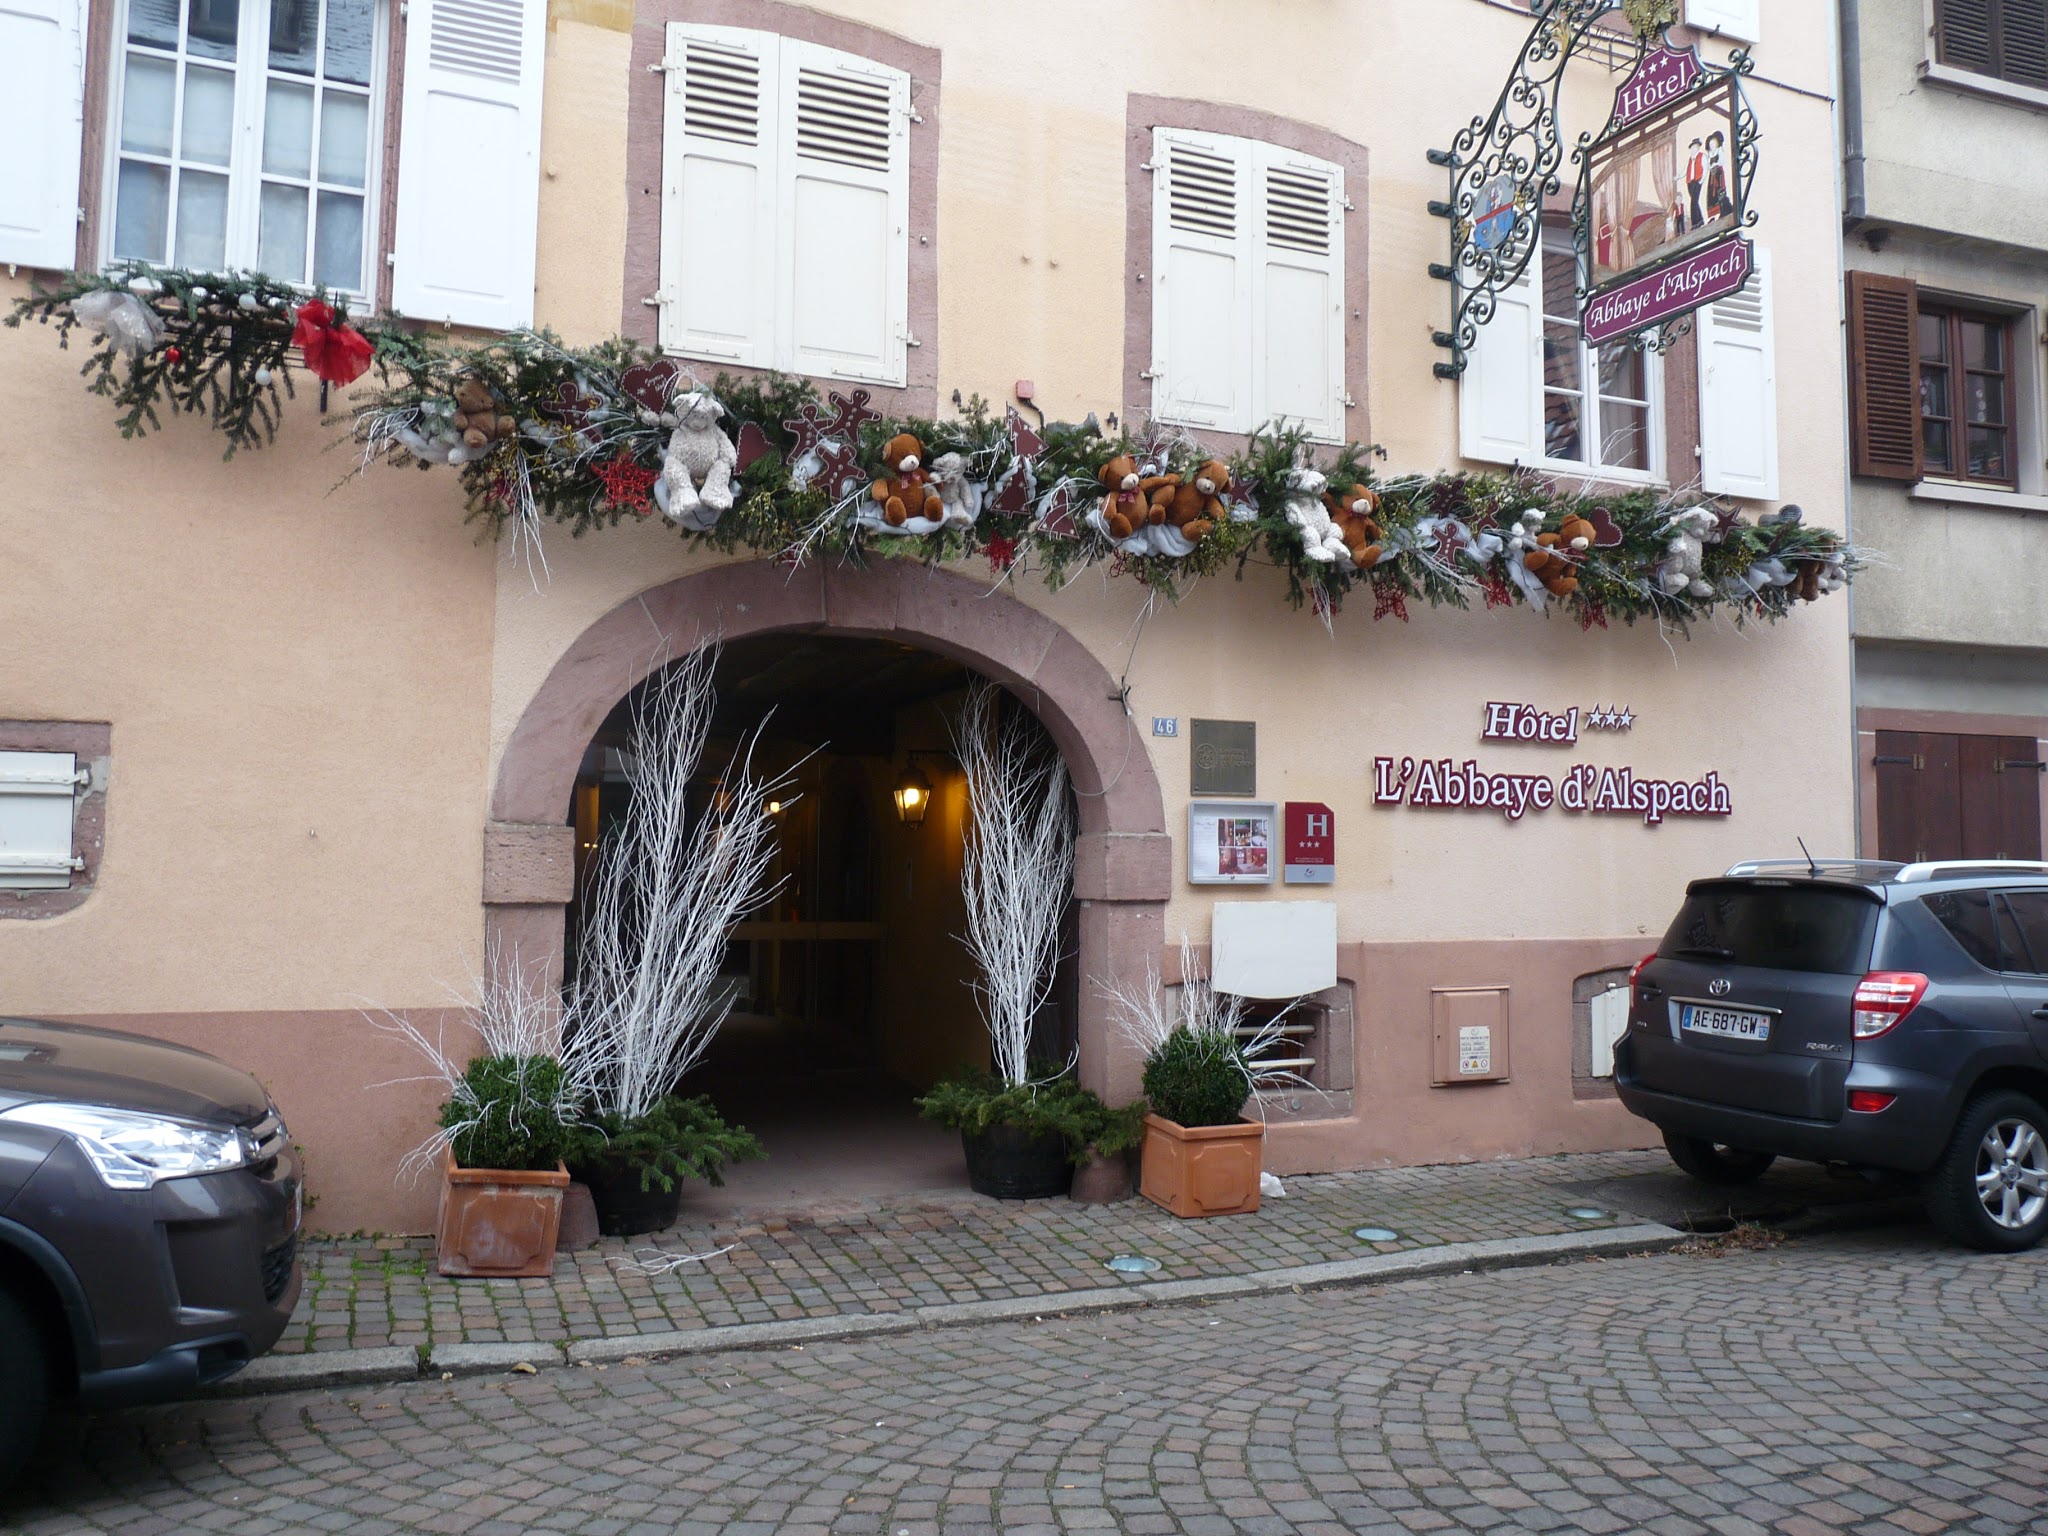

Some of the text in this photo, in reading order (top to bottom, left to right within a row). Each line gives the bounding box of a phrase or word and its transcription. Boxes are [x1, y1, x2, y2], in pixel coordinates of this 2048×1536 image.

[1622, 61, 1686, 119] Hôtel
[1590, 249, 1741, 327] Abbaye d'Alspach
[1157, 718, 1174, 734] 46
[1483, 701, 1579, 745] Hôtel
[1374, 757, 1732, 824] L'Abbaye d'Alspach
[1306, 813, 1329, 837] H
[1693, 1009, 1758, 1035] AE-687-GW
